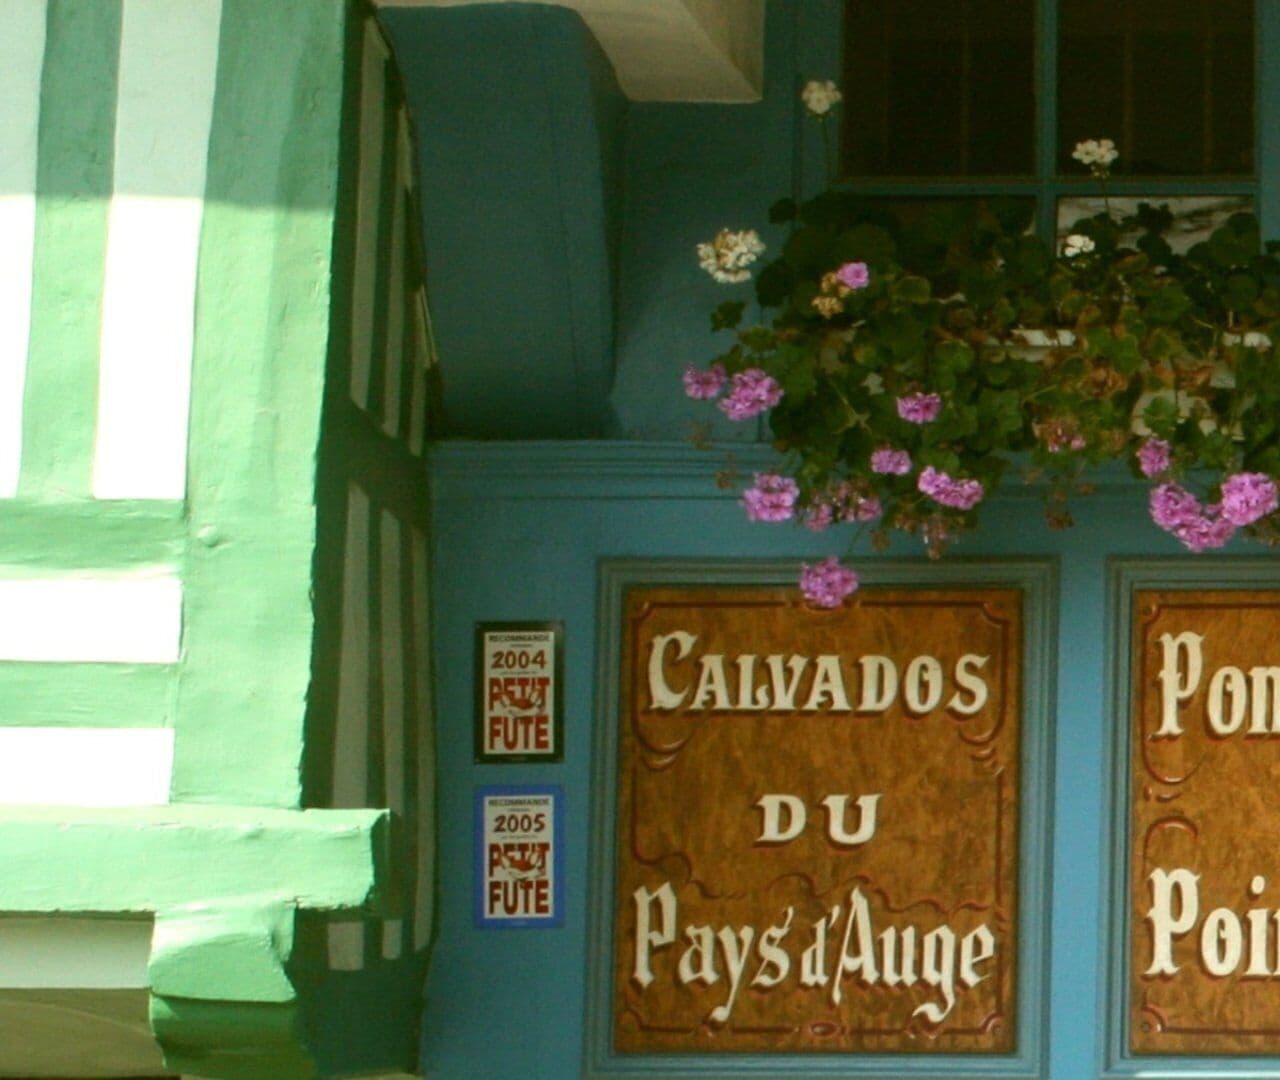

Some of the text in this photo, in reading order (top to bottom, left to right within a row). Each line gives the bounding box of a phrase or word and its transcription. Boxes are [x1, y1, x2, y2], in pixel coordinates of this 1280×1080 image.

[491, 649, 547, 669] 2004
[648, 630, 991, 715] CALVADOS
[488, 677, 551, 712] PETIT
[493, 813, 546, 833] 2005
[755, 793, 881, 845] DU
[488, 842, 551, 877] PETIT
[632, 882, 995, 1023] Pays d'Auge
